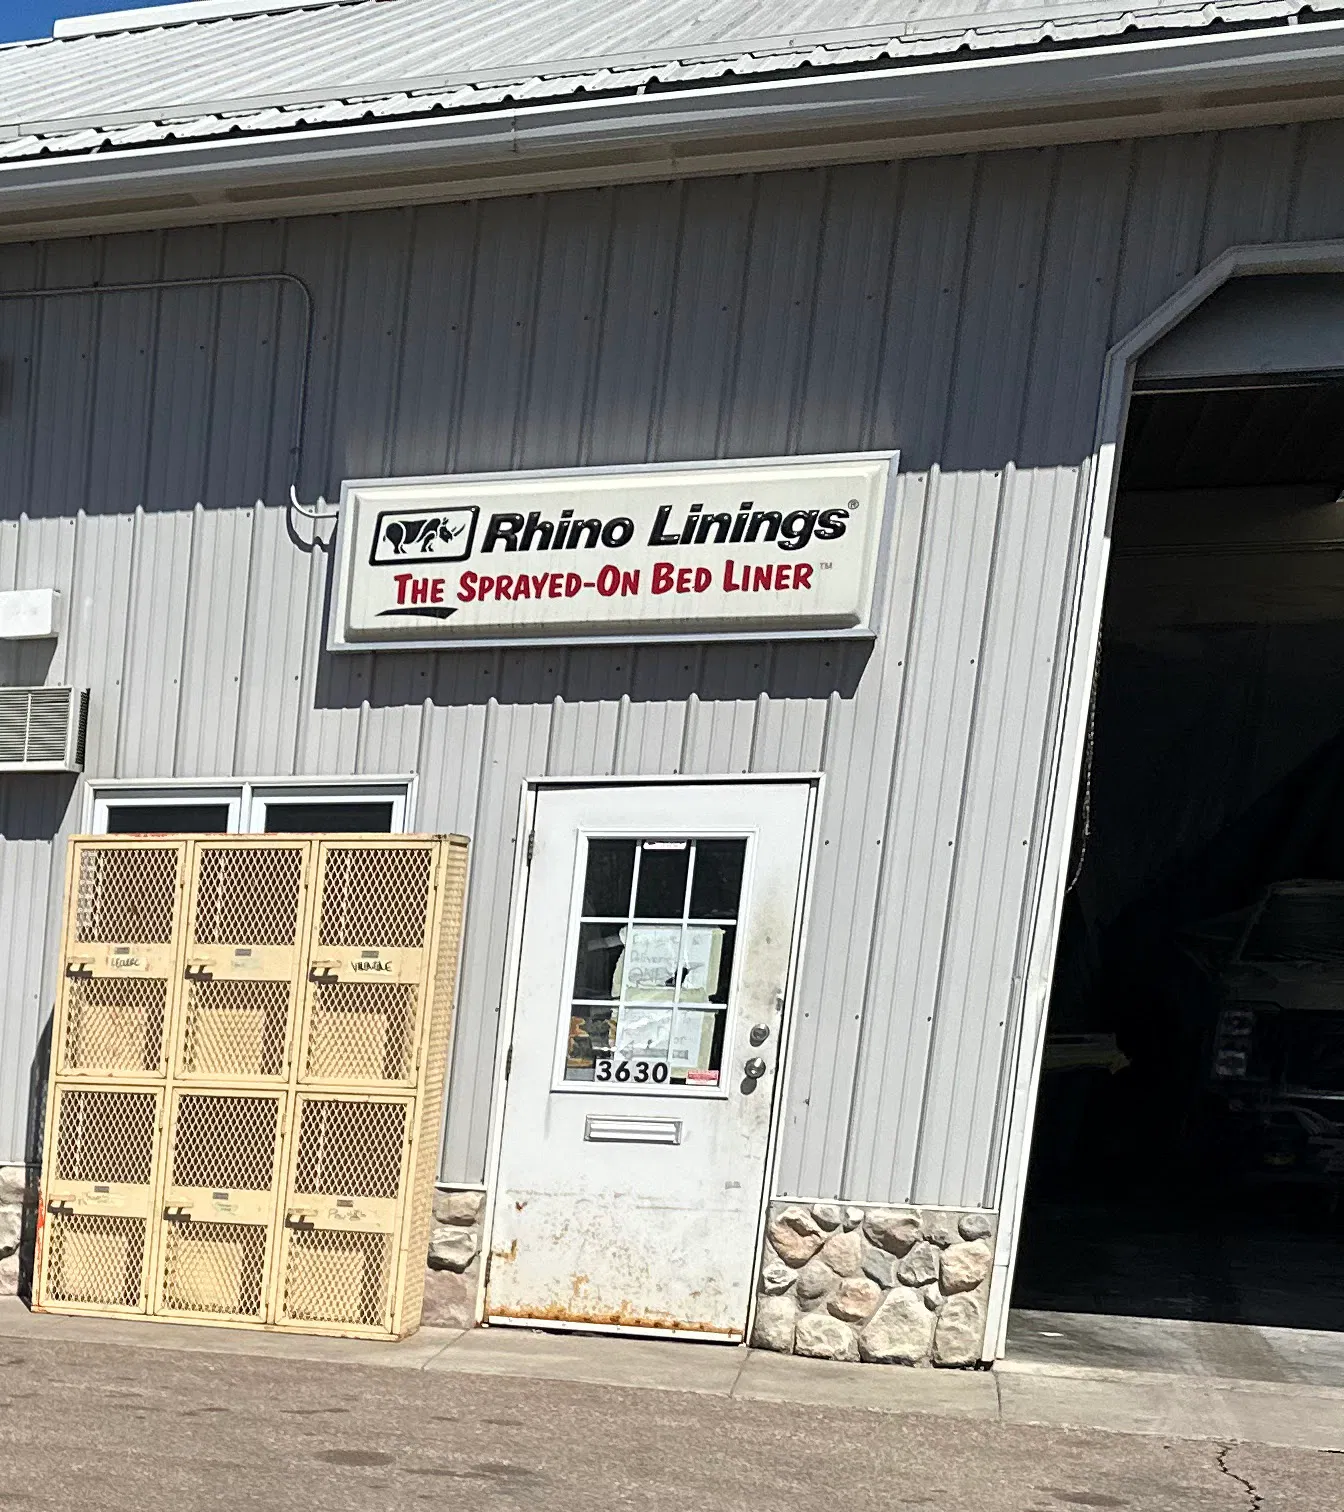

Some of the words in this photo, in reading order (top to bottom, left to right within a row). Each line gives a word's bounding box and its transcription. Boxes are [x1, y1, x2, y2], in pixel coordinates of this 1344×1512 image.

[480, 509, 635, 554] Rhino
[393, 571, 446, 606] THE
[458, 563, 640, 603] SPRAYED-ON
[651, 561, 713, 595] BED
[723, 559, 813, 593] LINER
[596, 1060, 669, 1084] 3630
